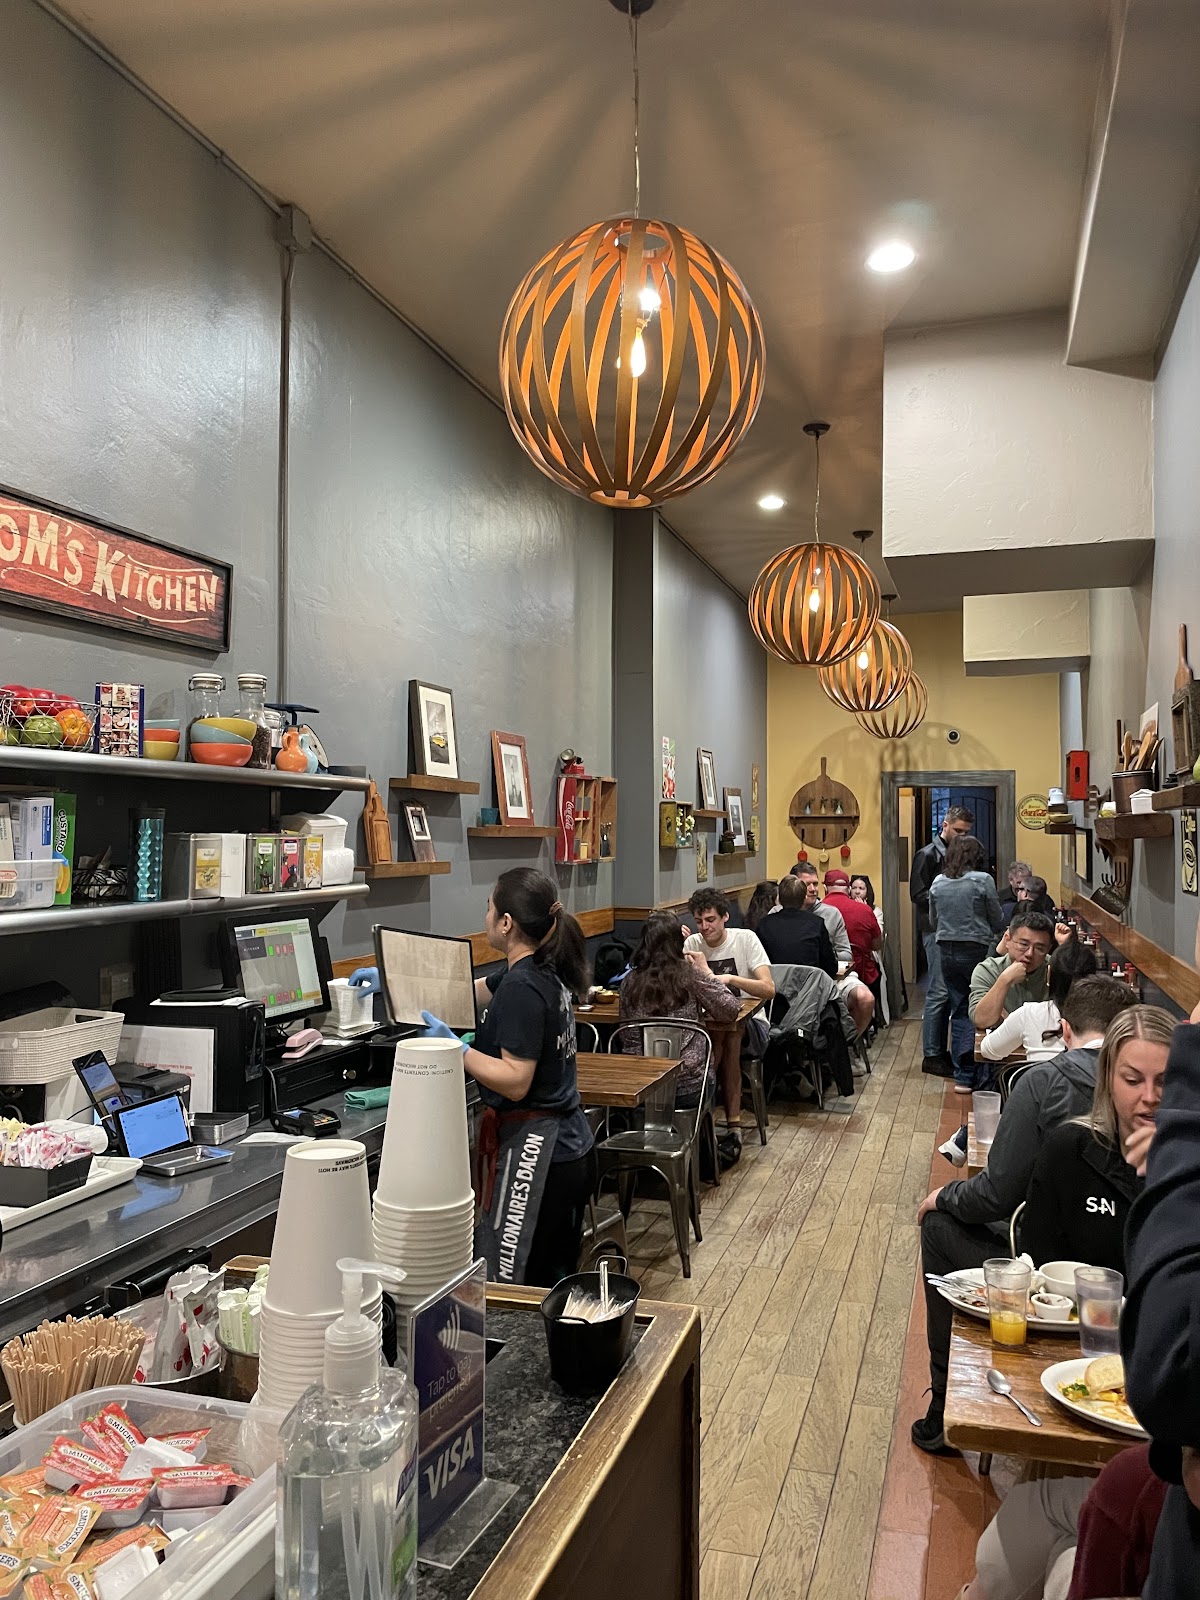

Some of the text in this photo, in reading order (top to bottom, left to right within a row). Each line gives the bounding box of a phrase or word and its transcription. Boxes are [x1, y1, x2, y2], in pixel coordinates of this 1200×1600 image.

[91, 541, 219, 613] KITCHEN
[56, 809, 67, 853] CUSTARD
[564, 801, 575, 831] Coca-Cola
[499, 1180, 531, 1281] MILLIONAIRE'S
[427, 1353, 472, 1399] Tap to pay
[429, 1371, 471, 1423] preferred
[107, 1417, 137, 1449] SMUCKE
[423, 1425, 475, 1500] VISA
